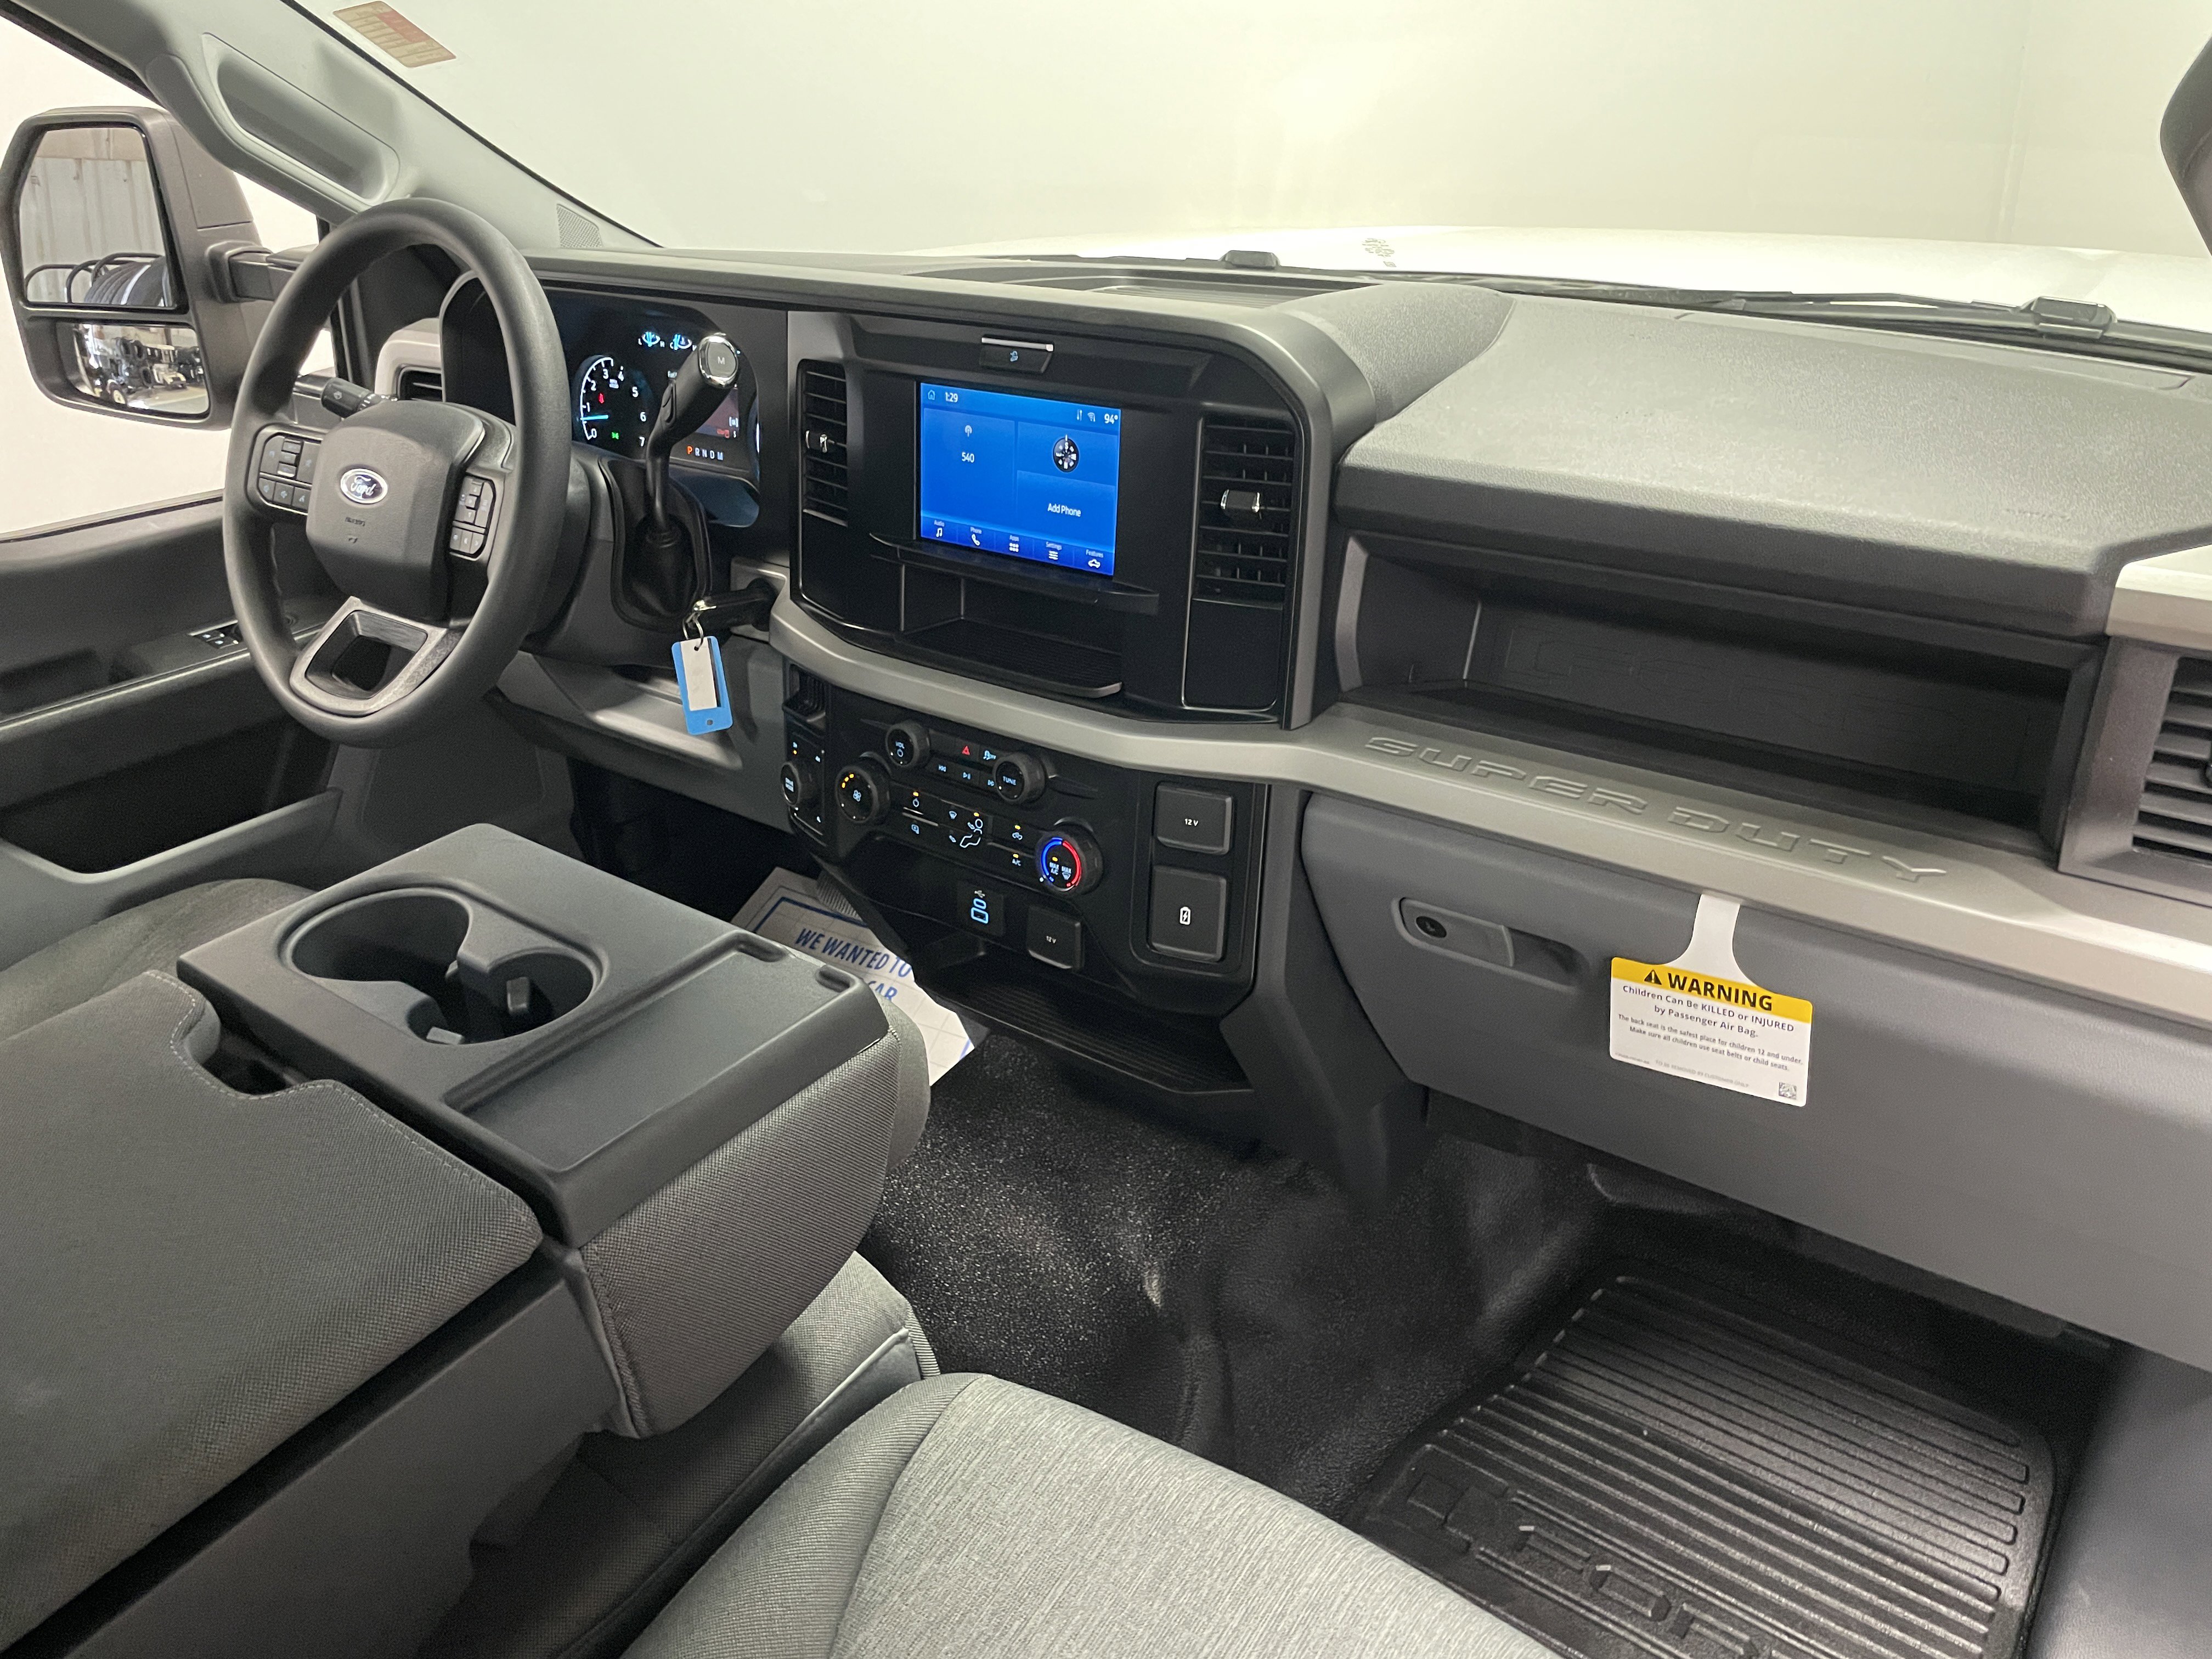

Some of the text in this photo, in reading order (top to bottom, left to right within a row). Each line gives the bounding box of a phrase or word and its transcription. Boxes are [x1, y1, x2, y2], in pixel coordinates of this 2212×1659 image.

[717, 356, 725, 365] M
[602, 368, 609, 379] 3
[618, 371, 624, 381] 4
[590, 380, 596, 391] 2
[632, 386, 639, 397] 5
[945, 392, 958, 403] 1:29
[586, 402, 590, 412] 1
[640, 411, 647, 422] 6
[1104, 413, 1119, 425] 94°
[590, 428, 597, 438] 0
[639, 436, 645, 447] 7
[961, 452, 975, 463] 540
[350, 475, 377, 496] Ford
[1047, 503, 1081, 517] Add Phone
[934, 519, 945, 527] Audio
[970, 526, 983, 535] Phone
[1046, 541, 1062, 551] Settings
[1086, 549, 1104, 558] Features
[895, 741, 905, 749] VOL
[1003, 776, 1017, 786] TUNE
[1364, 736, 1947, 883] SUPER DUTY
[794, 927, 820, 951] WE
[821, 935, 890, 970] WANTED
[1667, 972, 1773, 1012] WARNING
[1623, 985, 1662, 1001] Children
[1666, 995, 1684, 1005] Can
[1686, 1000, 1699, 1009] Be
[1701, 1003, 1735, 1018] KILLED
[1751, 1015, 1795, 1032] INJURED
[1654, 1005, 1758, 1038] by Passenger Air Bag.
[1618, 1013, 1629, 1022] The
[1630, 1017, 1645, 1026] back
[1667, 1025, 1678, 1034] the
[1680, 1029, 1698, 1039] safest
[1700, 1034, 1717, 1043] place
[1729, 1041, 1756, 1053] children
[1767, 1051, 1780, 1059] and
[1781, 1054, 1803, 1065] under.
[1629, 1025, 1646, 1035] Make
[1672, 1036, 1697, 1048] children
[1712, 1047, 1725, 1056] seat
[1726, 1049, 1742, 1060] belts
[1753, 1057, 1769, 1066] child
